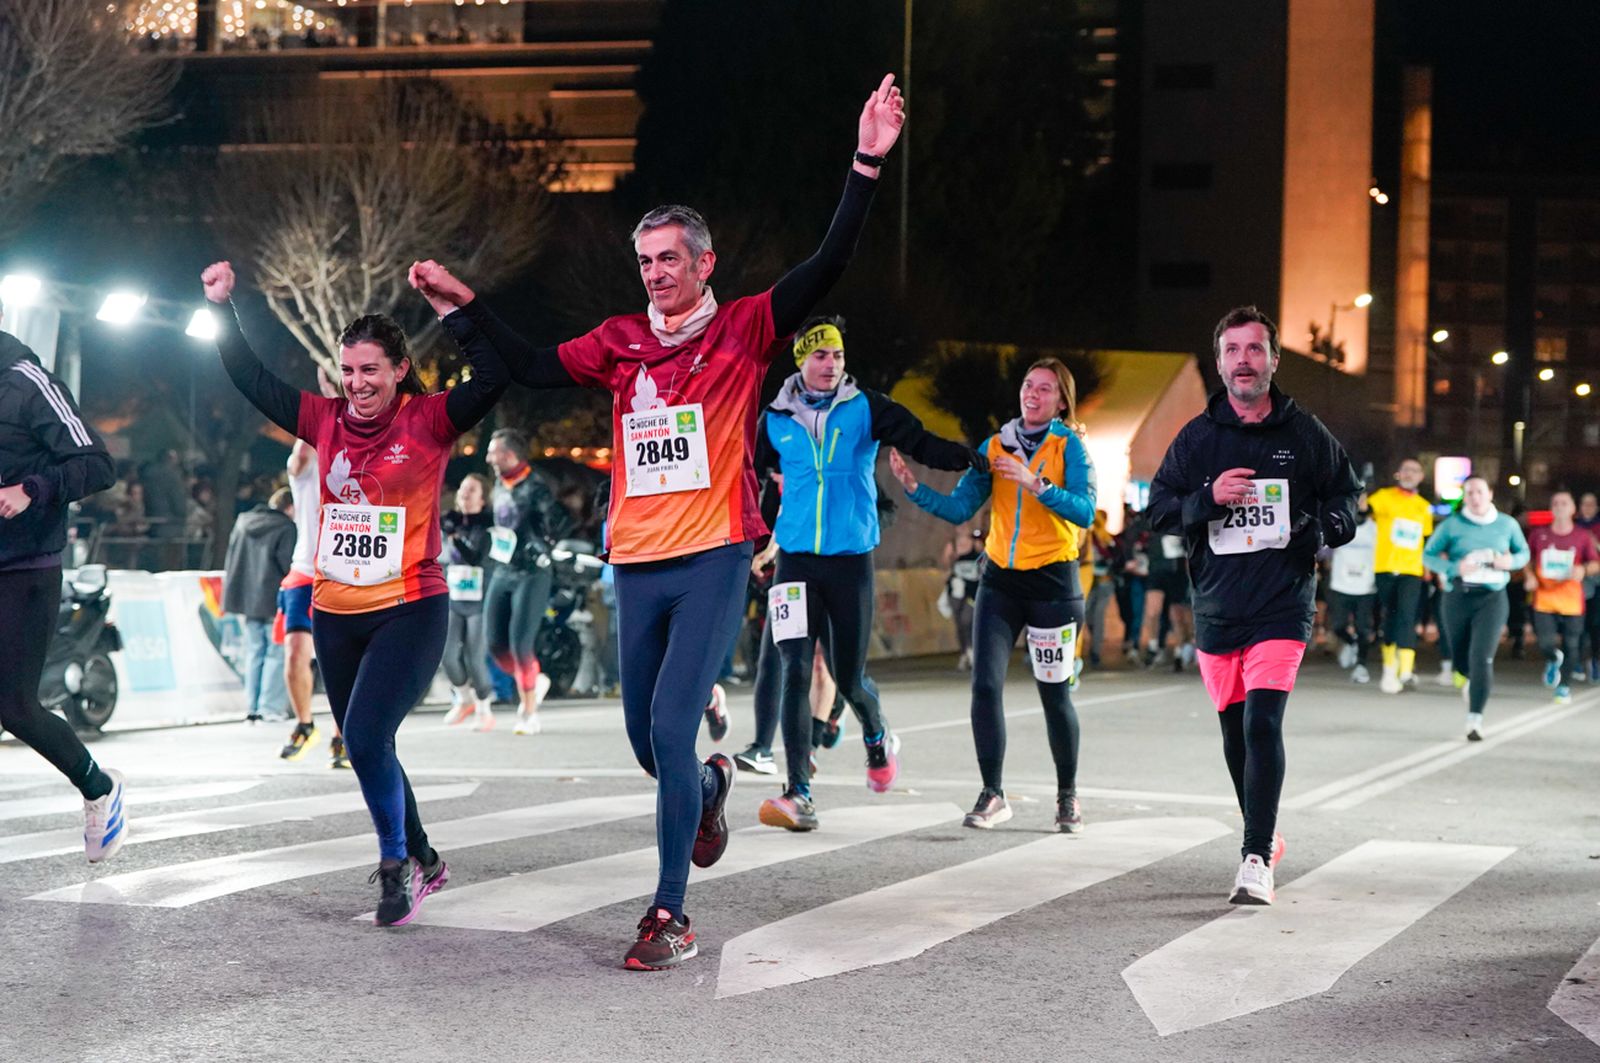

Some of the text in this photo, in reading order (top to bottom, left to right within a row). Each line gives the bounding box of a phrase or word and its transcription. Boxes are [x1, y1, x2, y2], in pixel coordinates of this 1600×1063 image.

[637, 419, 657, 429] NOCHE
[658, 417, 668, 426] DE
[630, 431, 643, 441] SAN
[643, 426, 670, 438] ANTÓN
[636, 436, 689, 466] 2849
[340, 484, 361, 505] 43
[338, 513, 360, 522] NOCHE
[361, 514, 371, 522] DE
[1223, 505, 1275, 528] 2335
[329, 522, 343, 531] SAN
[343, 522, 371, 532] ANTÓN
[332, 532, 387, 559] 2386
[1035, 647, 1064, 664] 994
